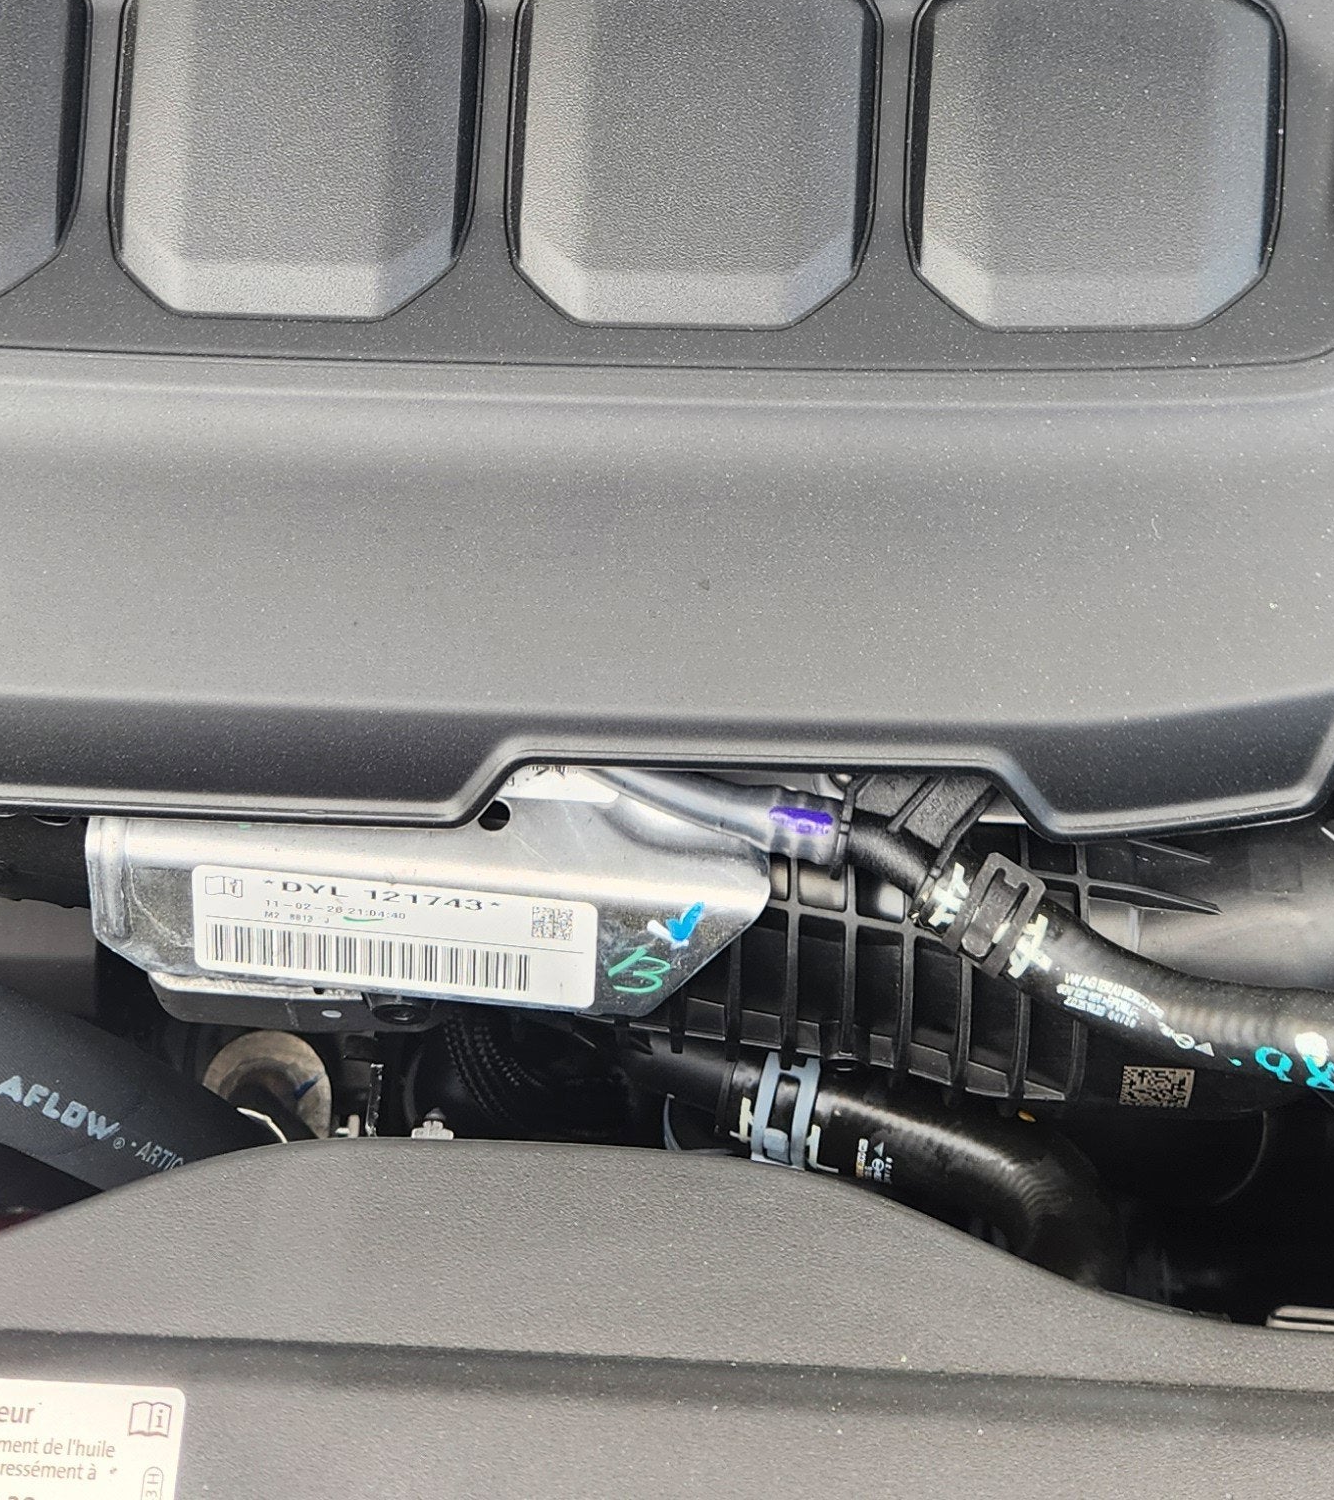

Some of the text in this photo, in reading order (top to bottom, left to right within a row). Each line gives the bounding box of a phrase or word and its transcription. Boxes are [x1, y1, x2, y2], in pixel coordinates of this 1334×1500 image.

[42, 1437, 63, 1456] de
[67, 1439, 116, 1459] l'huile
[87, 1463, 97, 1480] à
